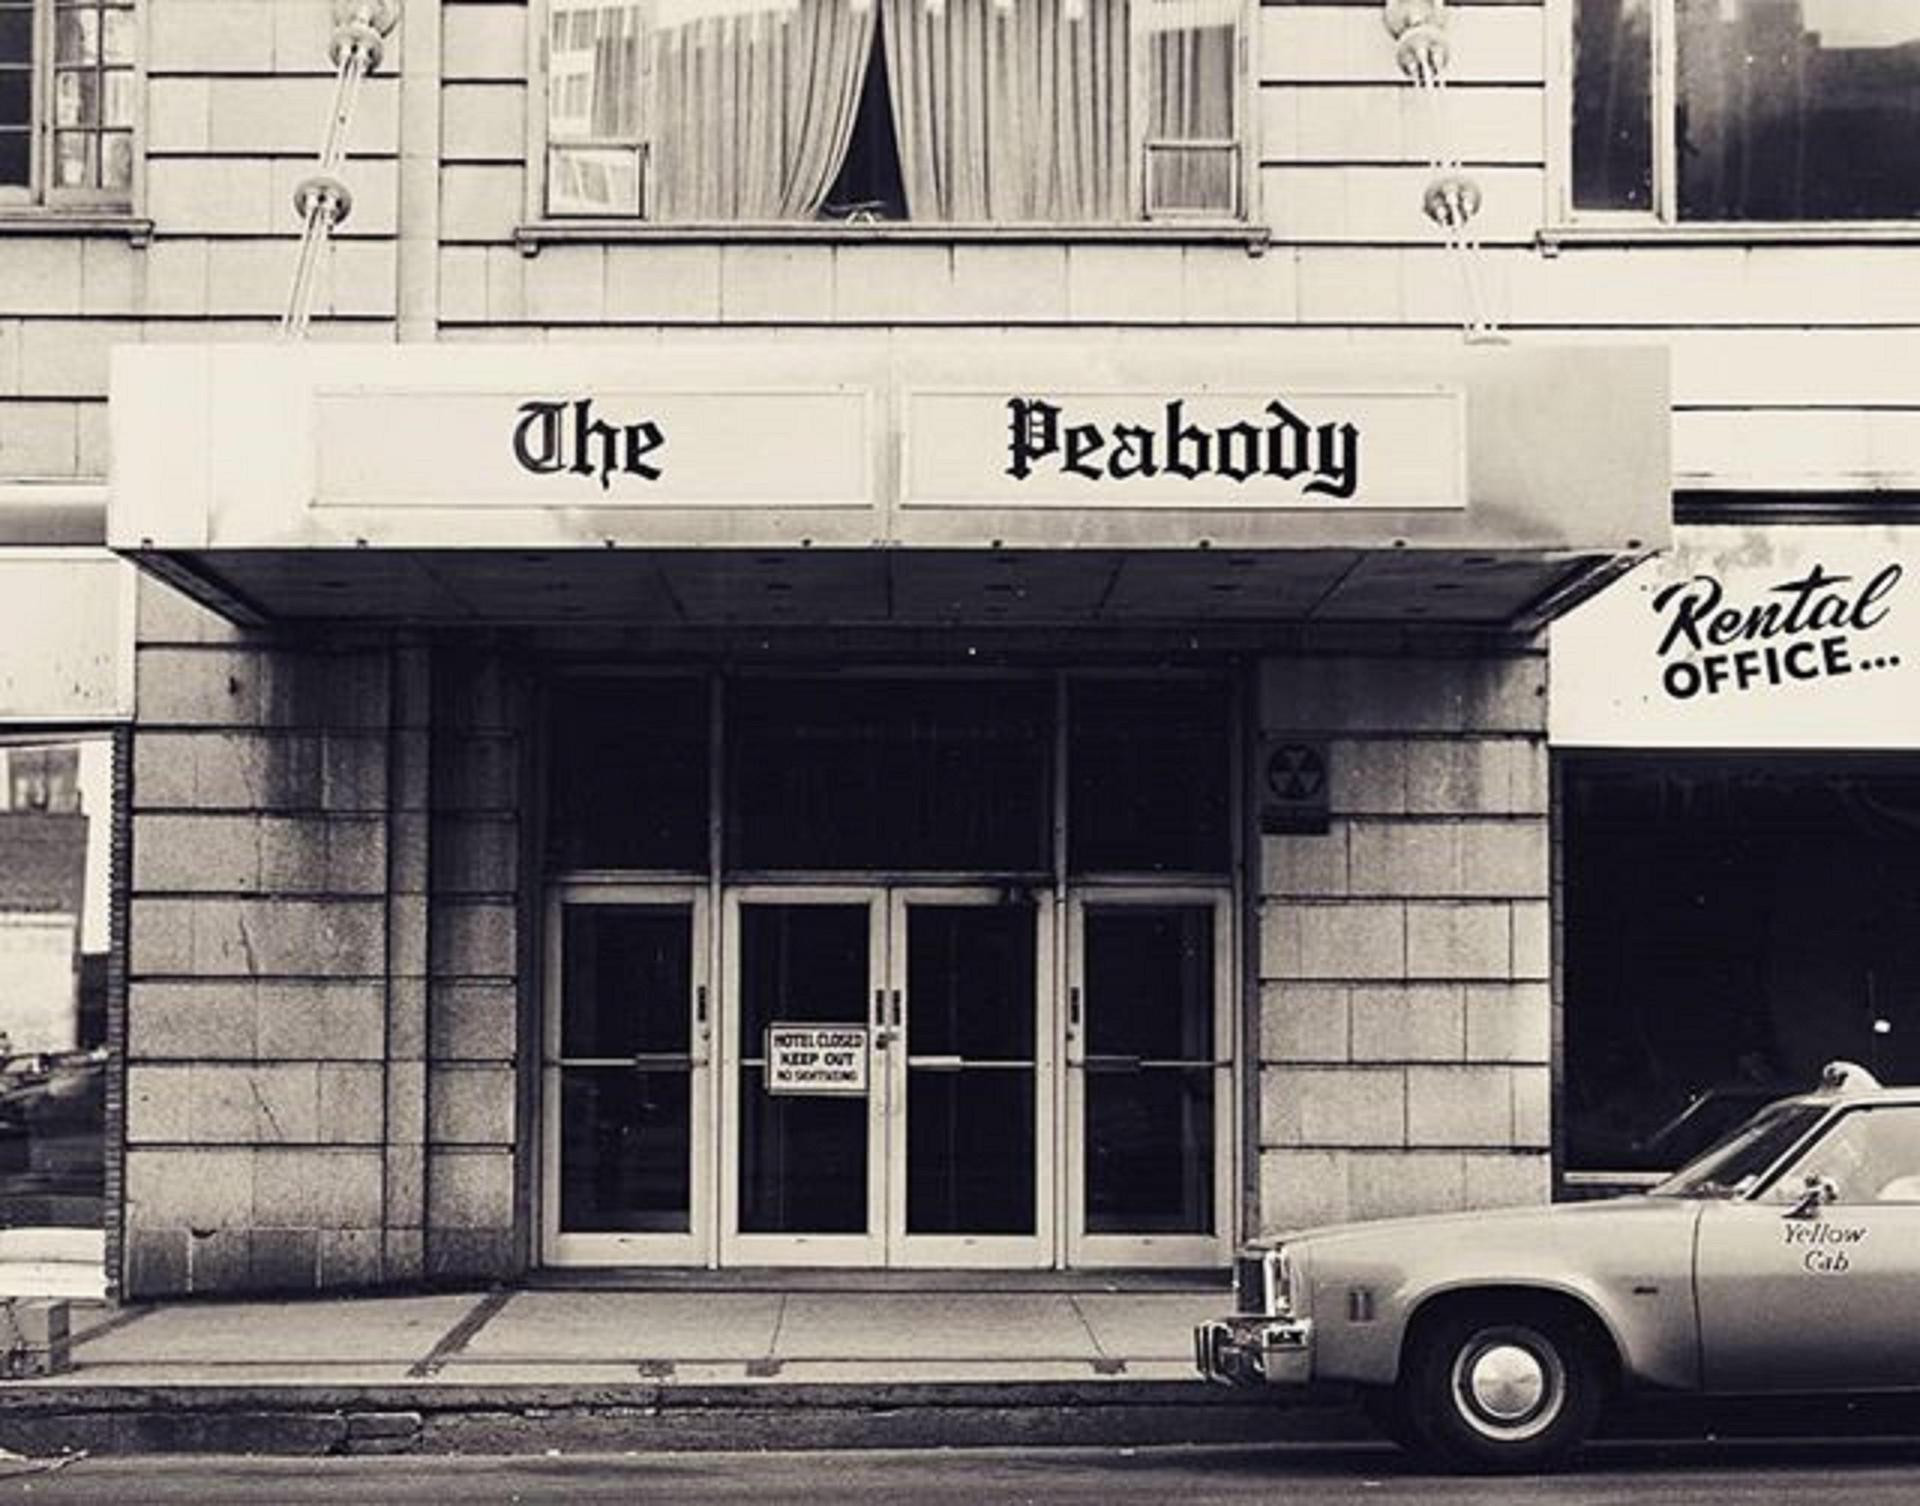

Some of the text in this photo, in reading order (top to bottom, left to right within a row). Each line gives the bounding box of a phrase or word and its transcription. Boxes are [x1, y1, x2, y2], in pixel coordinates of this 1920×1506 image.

[513, 397, 1360, 498] The Peabody
[1652, 564, 1903, 656] Rental
[774, 1033, 864, 1048] HOTEL CLOSED
[780, 1052, 854, 1066] KEEP OUT
[1785, 1223, 1867, 1243] Yellow
[1804, 1250, 1849, 1271] Cab
